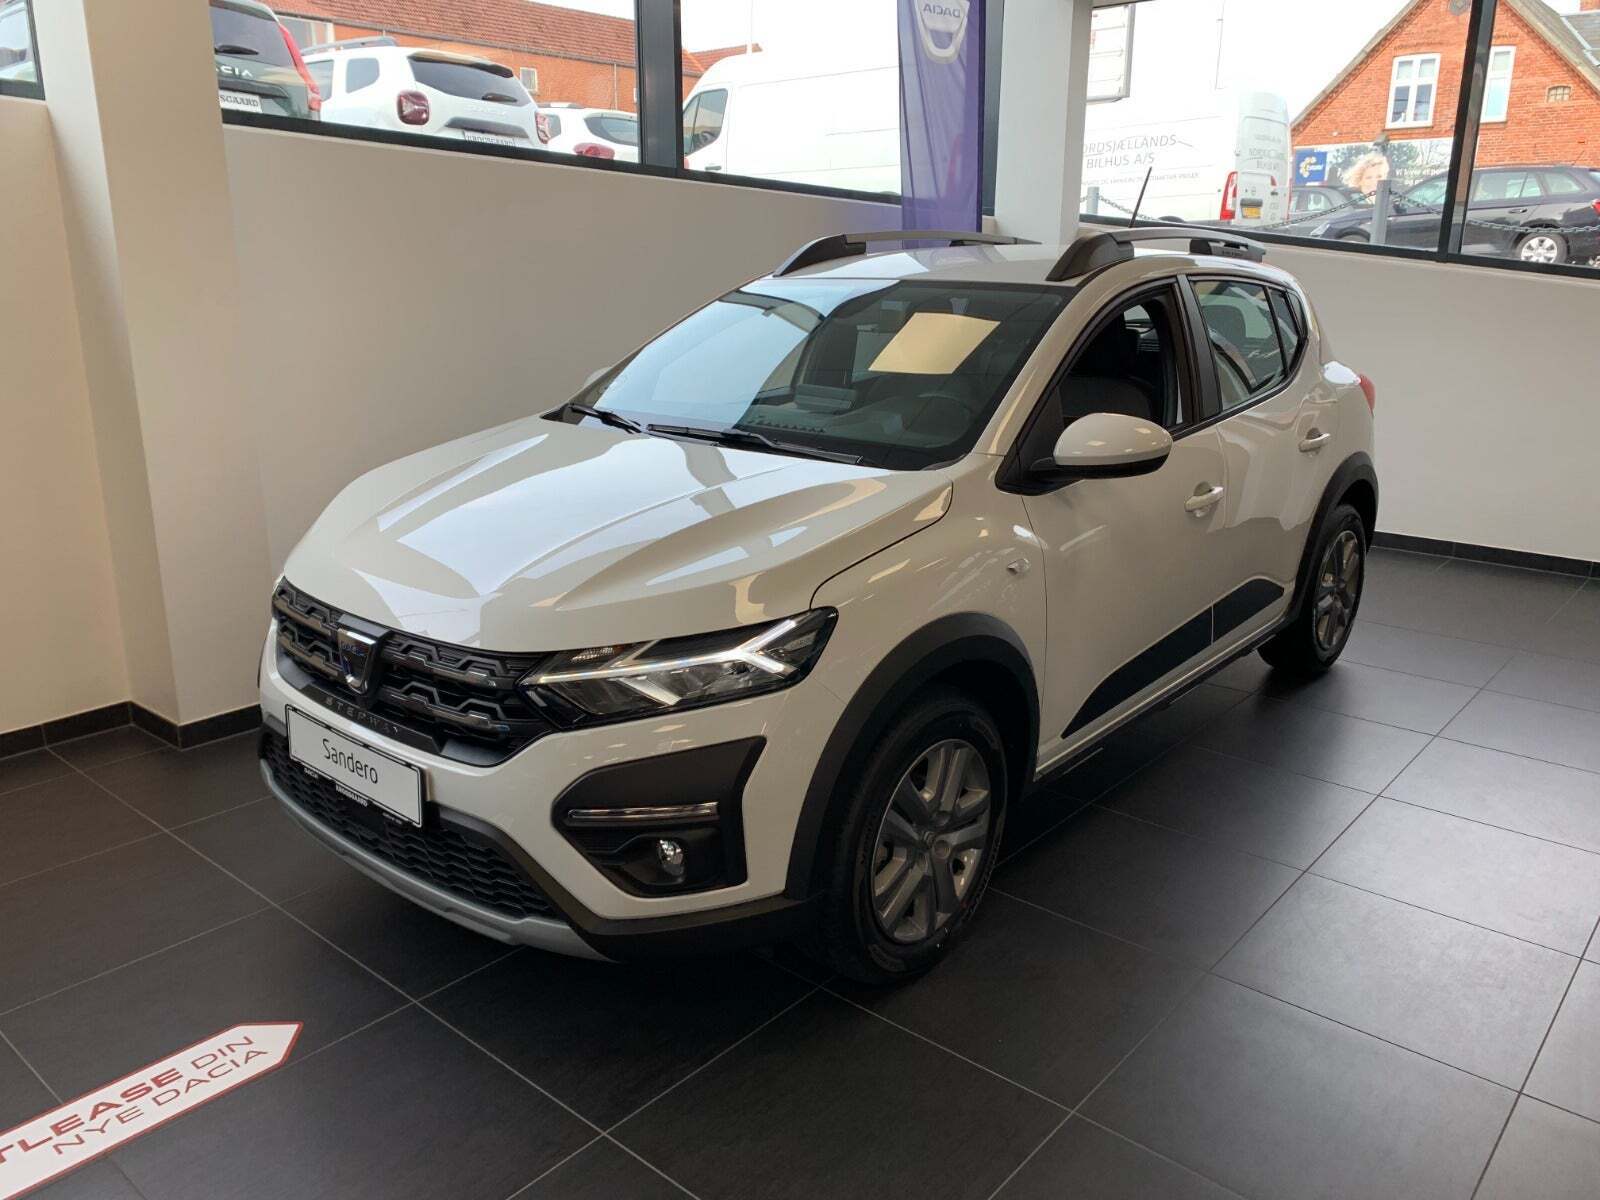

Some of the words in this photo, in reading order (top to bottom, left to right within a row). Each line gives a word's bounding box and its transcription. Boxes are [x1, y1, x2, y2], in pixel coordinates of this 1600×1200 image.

[216, 64, 253, 78] CIA
[1086, 154, 1130, 169] BILHUS
[322, 738, 379, 785] Sandero
[191, 1036, 254, 1070] DIN
[53, 1105, 144, 1154] NYE
[152, 1050, 268, 1107] DACIA
